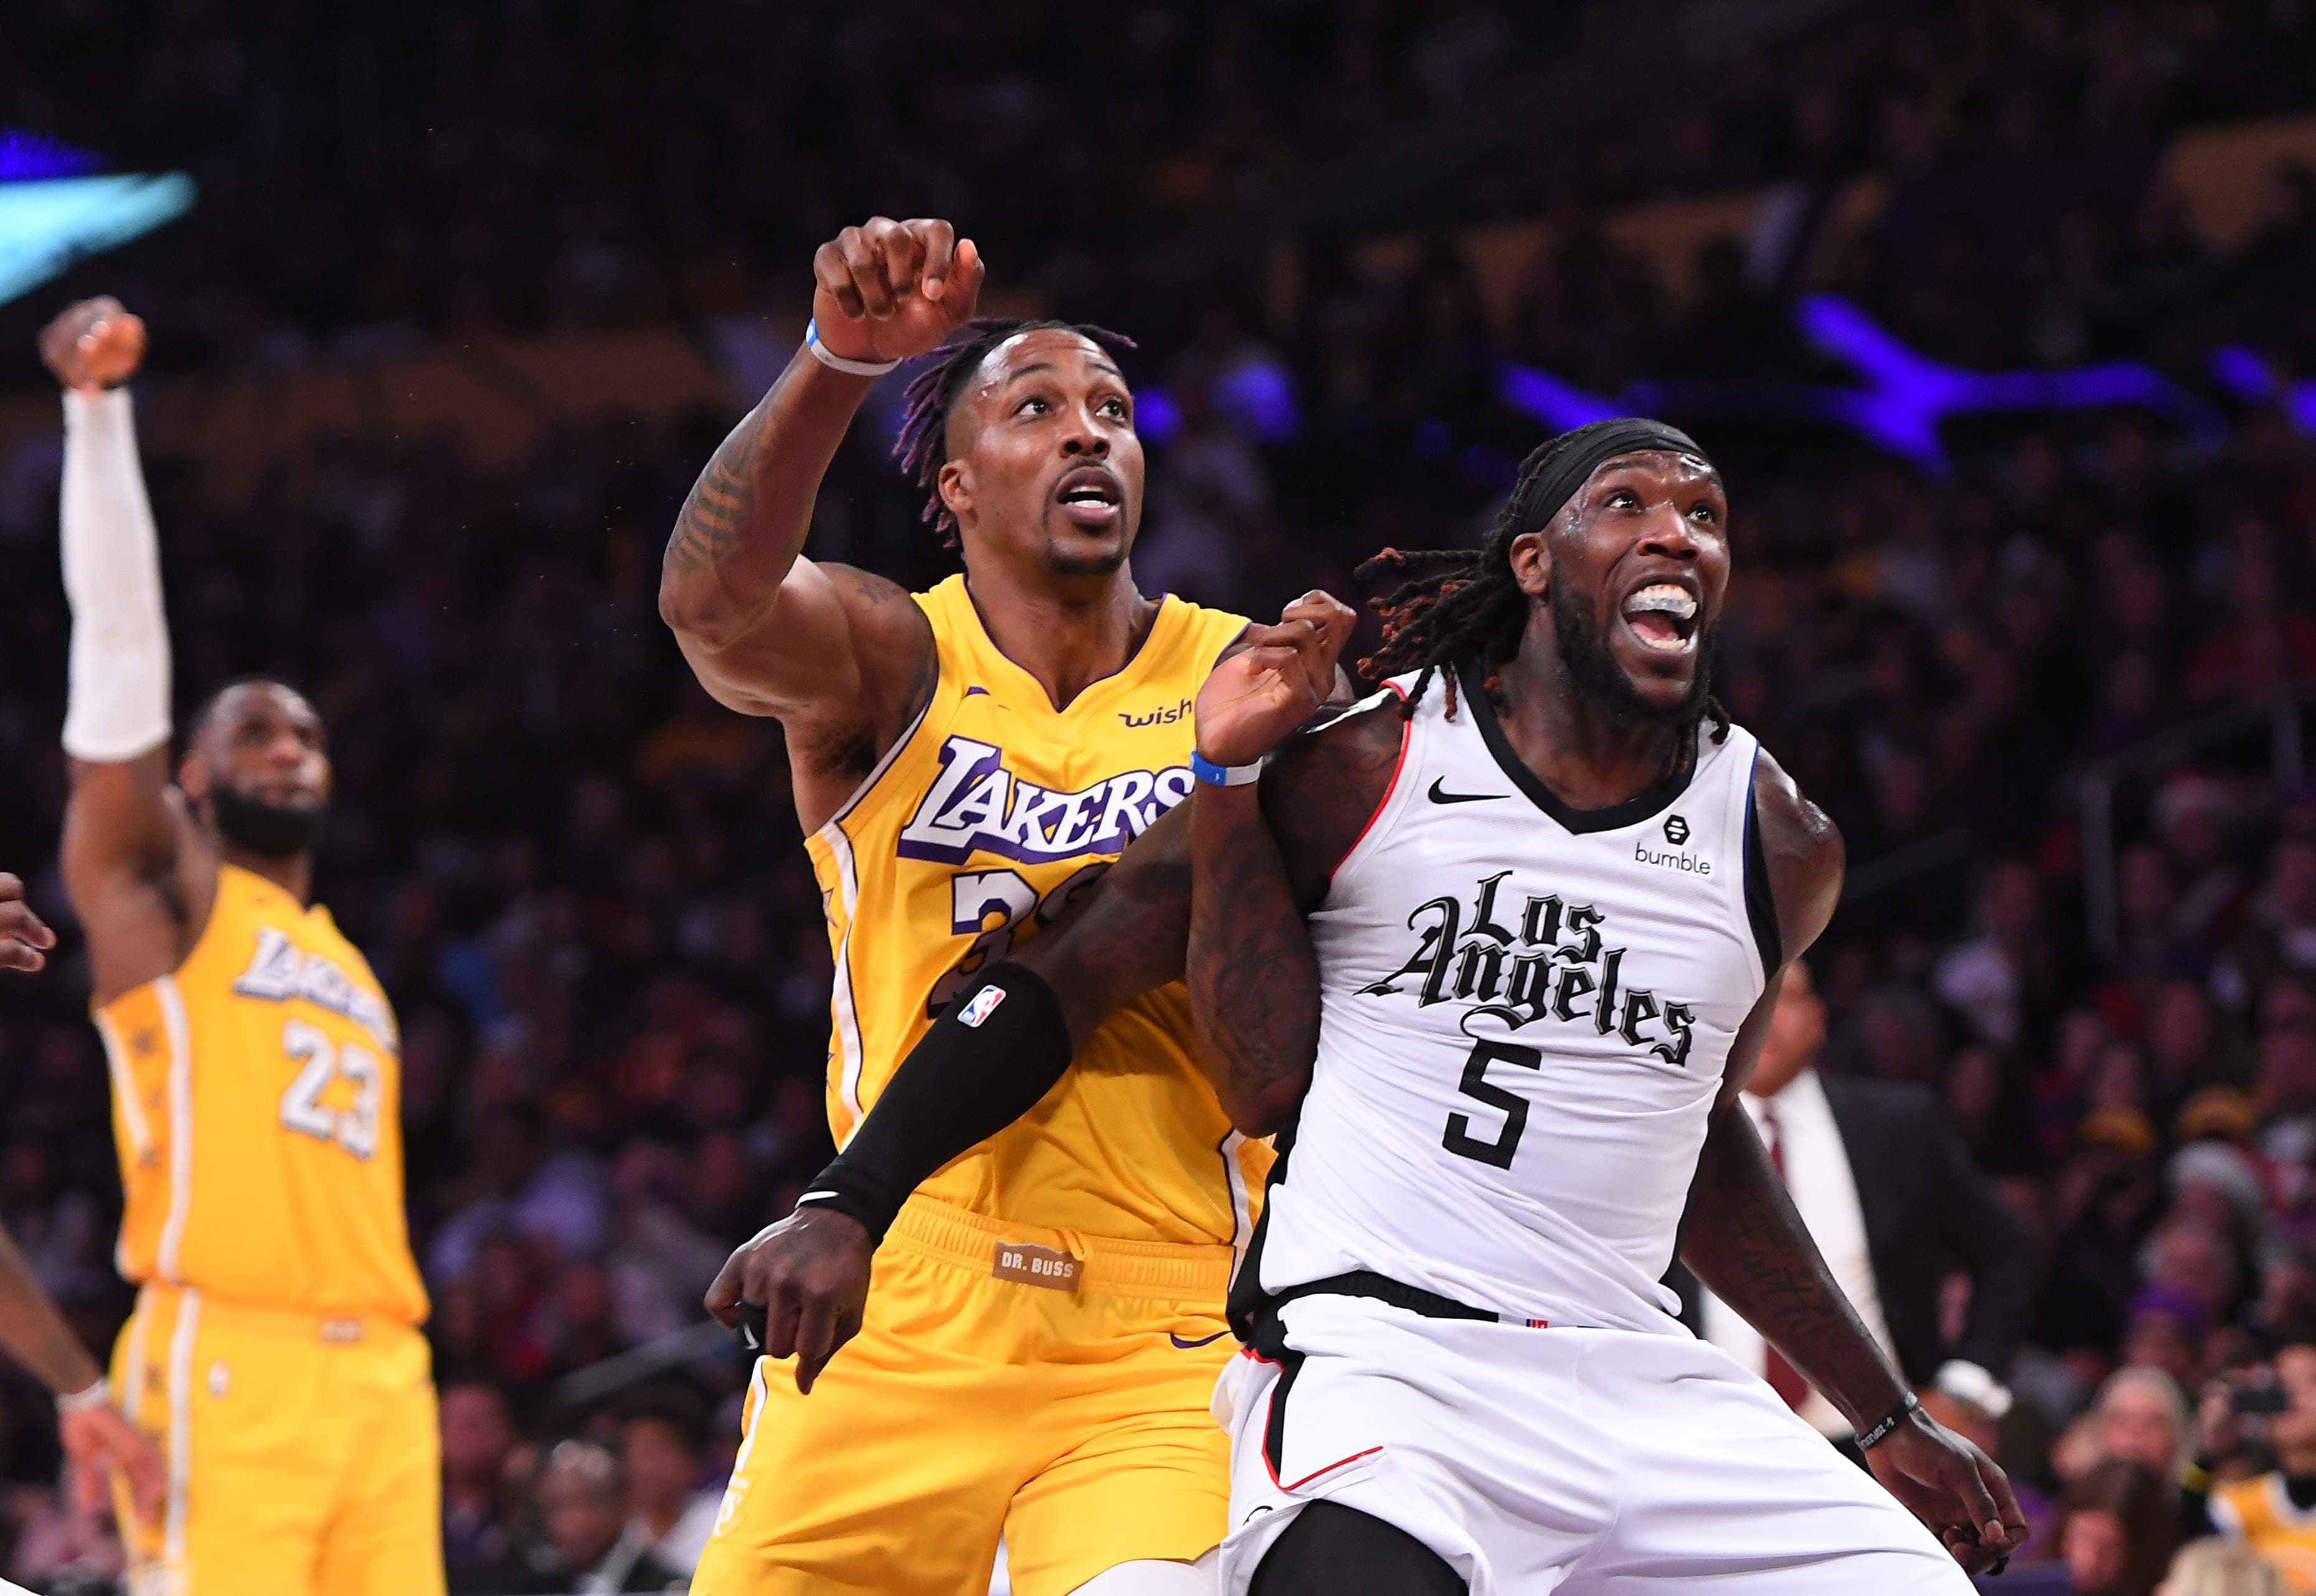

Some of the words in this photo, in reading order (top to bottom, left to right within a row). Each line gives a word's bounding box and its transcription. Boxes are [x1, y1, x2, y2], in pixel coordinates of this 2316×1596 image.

[1118, 698, 1192, 728] wish
[896, 733, 1196, 865] LAKERS
[1634, 842, 1711, 876] bumble
[1459, 870, 1606, 964] Los
[1352, 895, 1697, 1068] Angeles
[281, 1017, 381, 1159] 23
[1441, 1036, 1542, 1171] 5
[1000, 1251, 1028, 1271] DR.
[1030, 1257, 1075, 1278] BUSS
